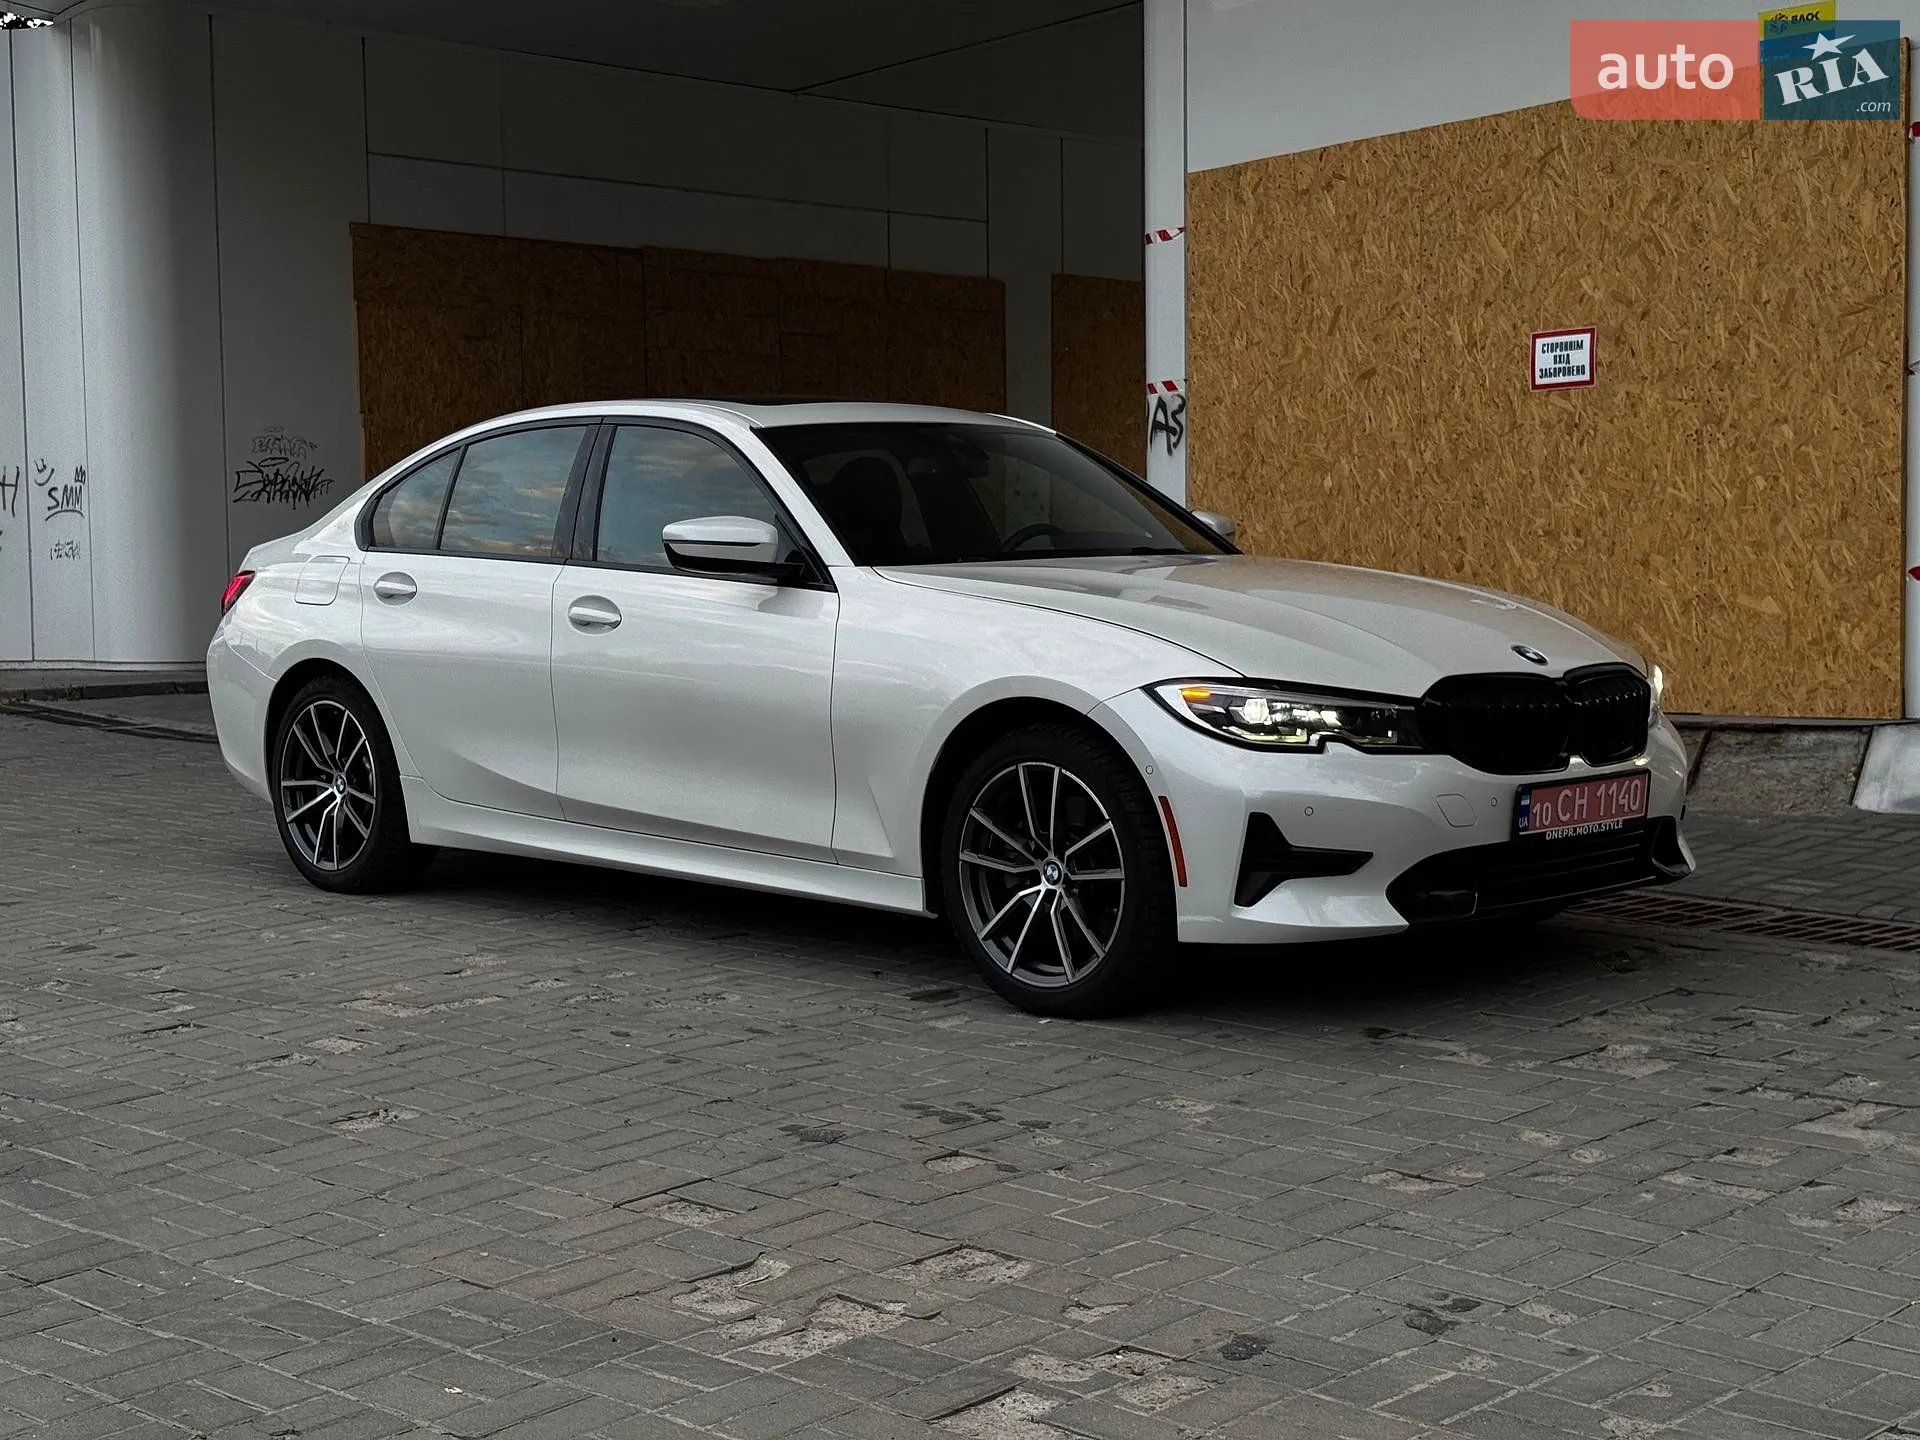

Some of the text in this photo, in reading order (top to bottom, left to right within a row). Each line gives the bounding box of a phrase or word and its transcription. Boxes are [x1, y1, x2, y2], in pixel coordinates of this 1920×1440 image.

[1541, 340, 1584, 354] СТОРОННІМ
[1553, 354, 1571, 366] ВХІД
[1539, 365, 1586, 379] ЗАБОРОНЕНО
[1518, 779, 1641, 829] UA 10 CH 1140
[1546, 820, 1624, 840] DNEPR.MOTO.STYLE
